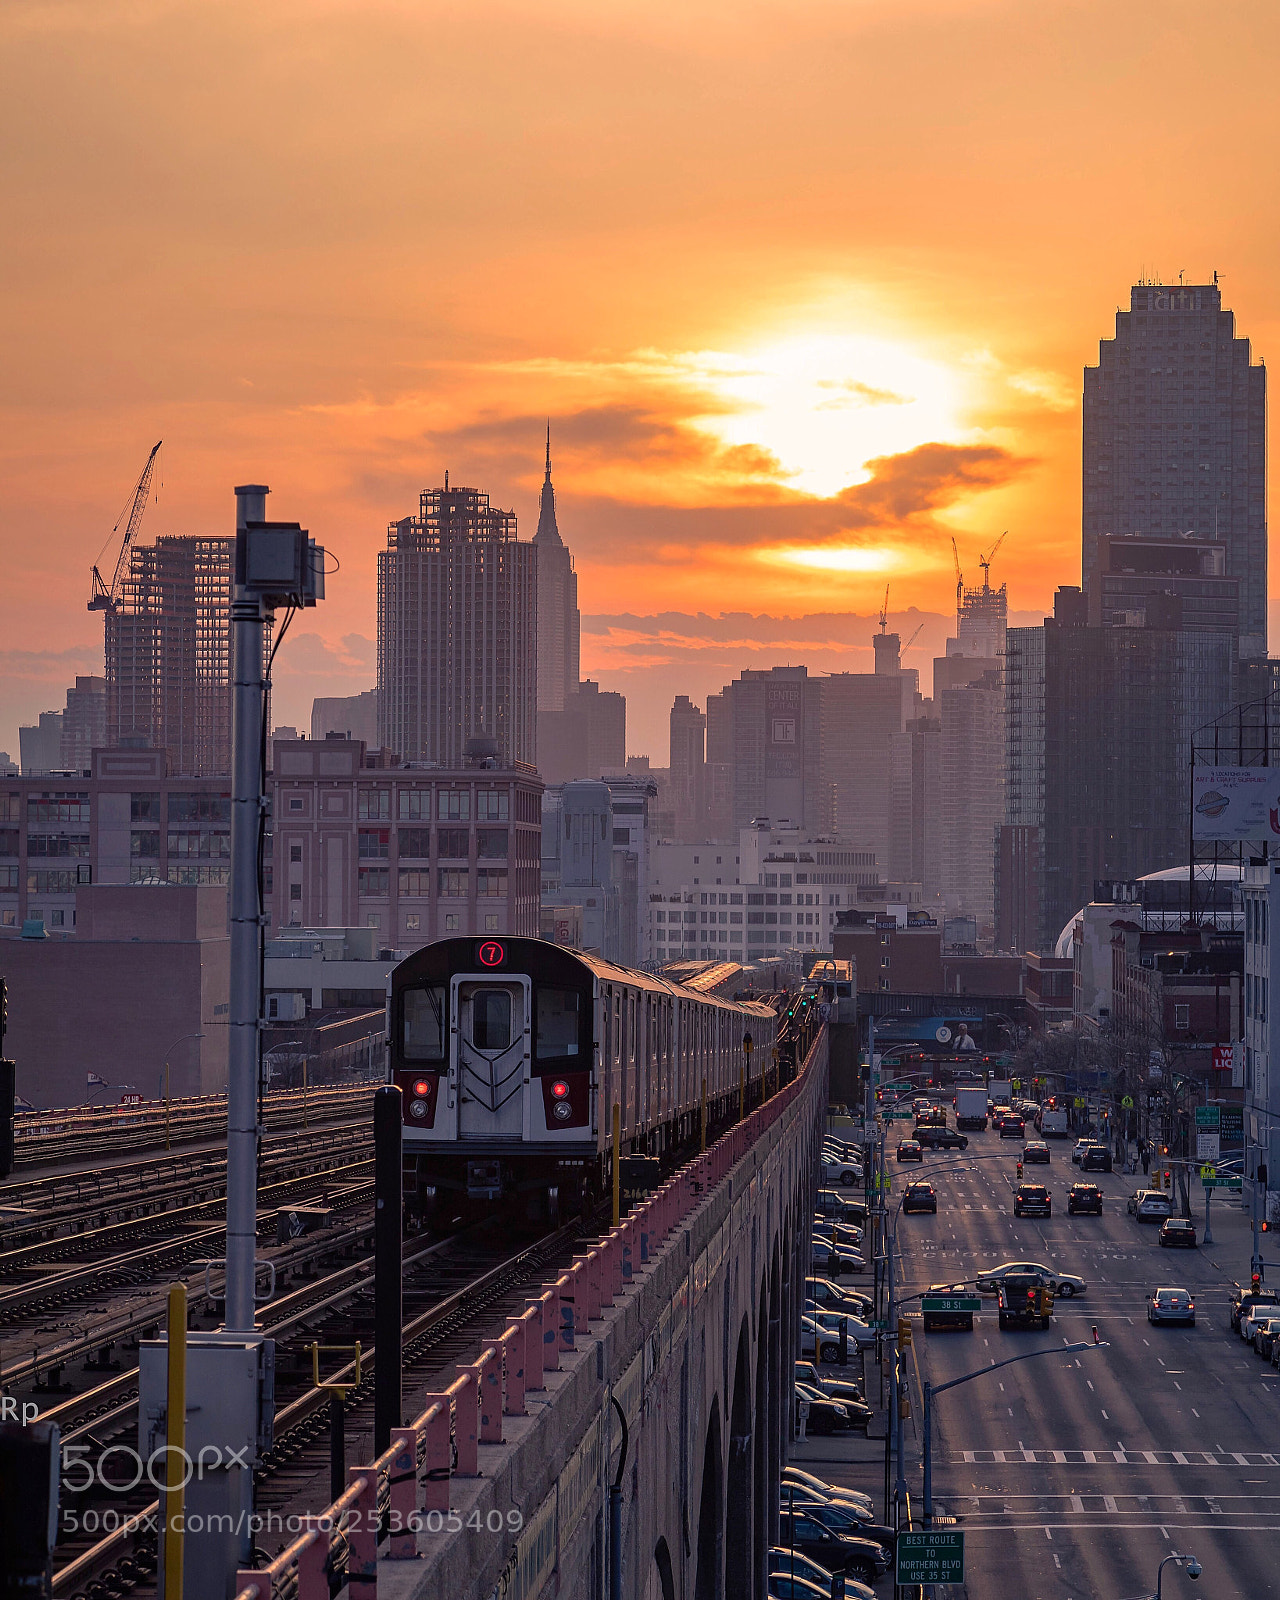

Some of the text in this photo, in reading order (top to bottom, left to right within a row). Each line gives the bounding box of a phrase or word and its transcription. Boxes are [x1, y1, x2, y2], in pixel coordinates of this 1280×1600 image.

[1154, 288, 1194, 311] citi
[768, 691, 800, 701] CENTER
[487, 947, 496, 961] 7
[942, 1301, 961, 1309] 38 St
[1, 1396, 39, 1427] Rp
[906, 1535, 956, 1545] BEST ROUTE
[925, 1549, 936, 1558] TO
[900, 1560, 961, 1570] NORTHERN BLVD
[910, 1571, 951, 1581] USE 35 ST
